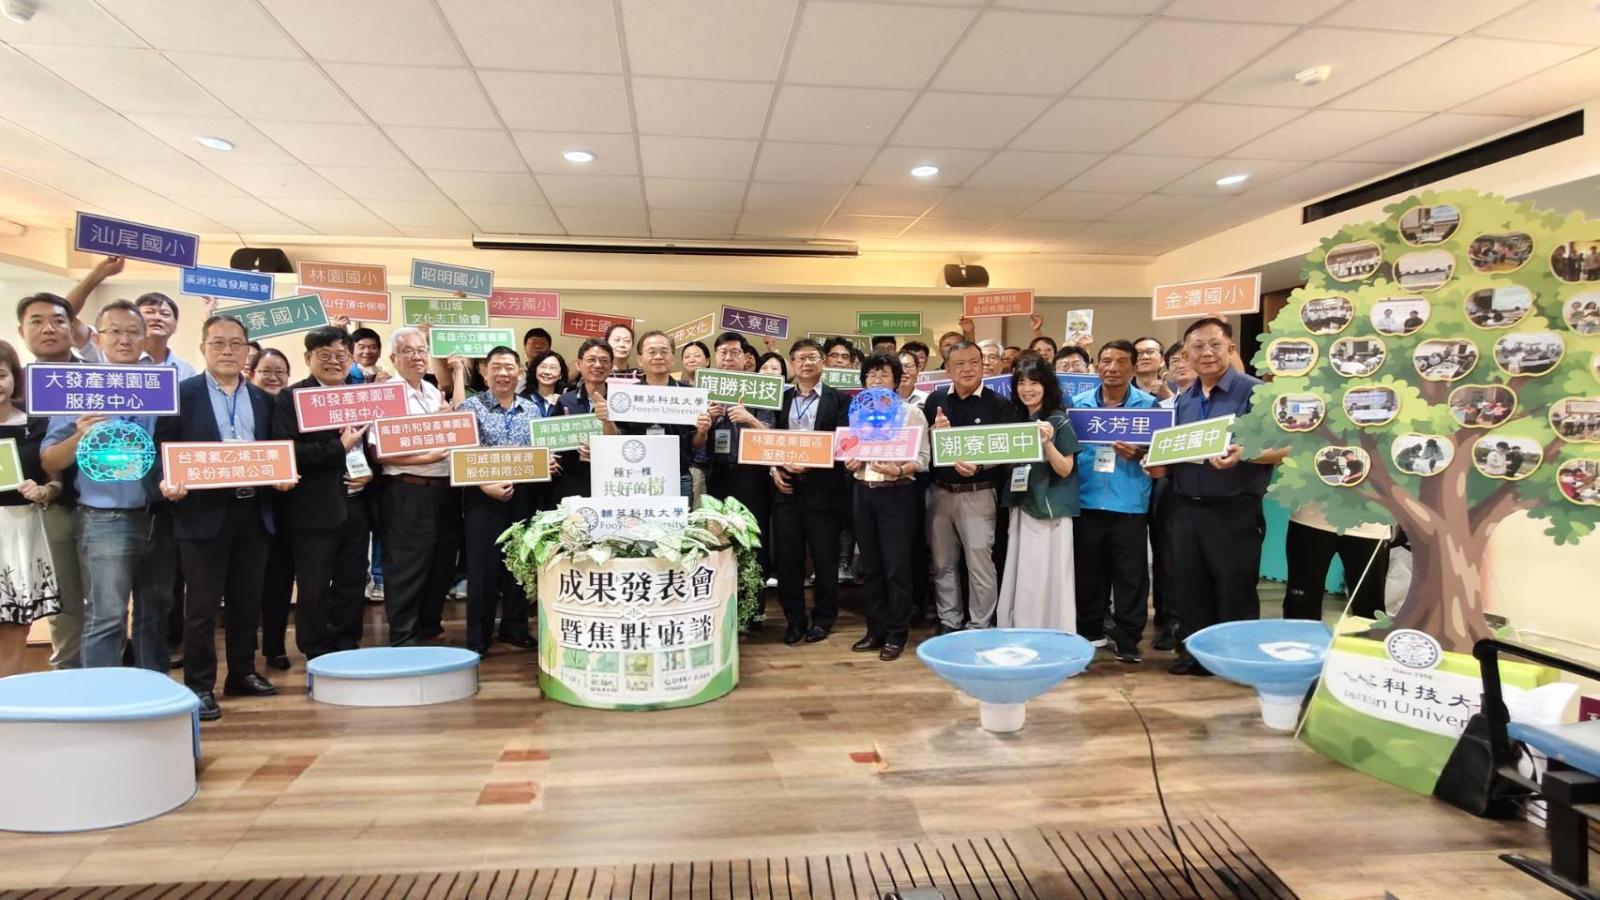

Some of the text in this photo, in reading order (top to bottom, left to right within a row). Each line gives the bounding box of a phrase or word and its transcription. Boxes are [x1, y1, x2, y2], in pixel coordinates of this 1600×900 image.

[90, 223, 185, 257] 汕尾國小
[308, 268, 377, 287] 林園國小
[421, 266, 485, 289] 昭明國小
[492, 295, 551, 312] 永芳國小
[1164, 284, 1244, 310] 金潭國小
[233, 302, 318, 332] 寮國小
[412, 312, 481, 325] 文化志工協會
[570, 316, 613, 334] 中庄國
[729, 312, 781, 334] 大寮區
[669, 321, 708, 342] 冊文化
[45, 371, 161, 390] 大發產業園區
[700, 374, 777, 401] 旗勝科技
[65, 393, 144, 410] 服務中心
[311, 387, 396, 411] 和發產業園區
[633, 394, 705, 408] 輔英科技大學
[329, 407, 385, 424] 服務中心
[632, 404, 661, 414] Fooyin
[1086, 416, 1151, 435] 永芳里
[400, 432, 457, 448] 廠商協進會
[940, 432, 1034, 457] 潮寮國中
[1158, 427, 1220, 455] 中芸國中
[177, 448, 280, 465] 台灣氯乙烯工業
[762, 450, 810, 462] 服務中心
[187, 464, 275, 481] 股份有限公司
[466, 466, 535, 479] 股份有限公司
[614, 467, 651, 479] 種下一棵
[603, 476, 666, 497] 共好的樹
[601, 507, 684, 518] 輔英科技大學
[559, 567, 713, 602] 成果發表會
[1341, 671, 1472, 707] 科技大
[1394, 699, 1469, 728] Univer
